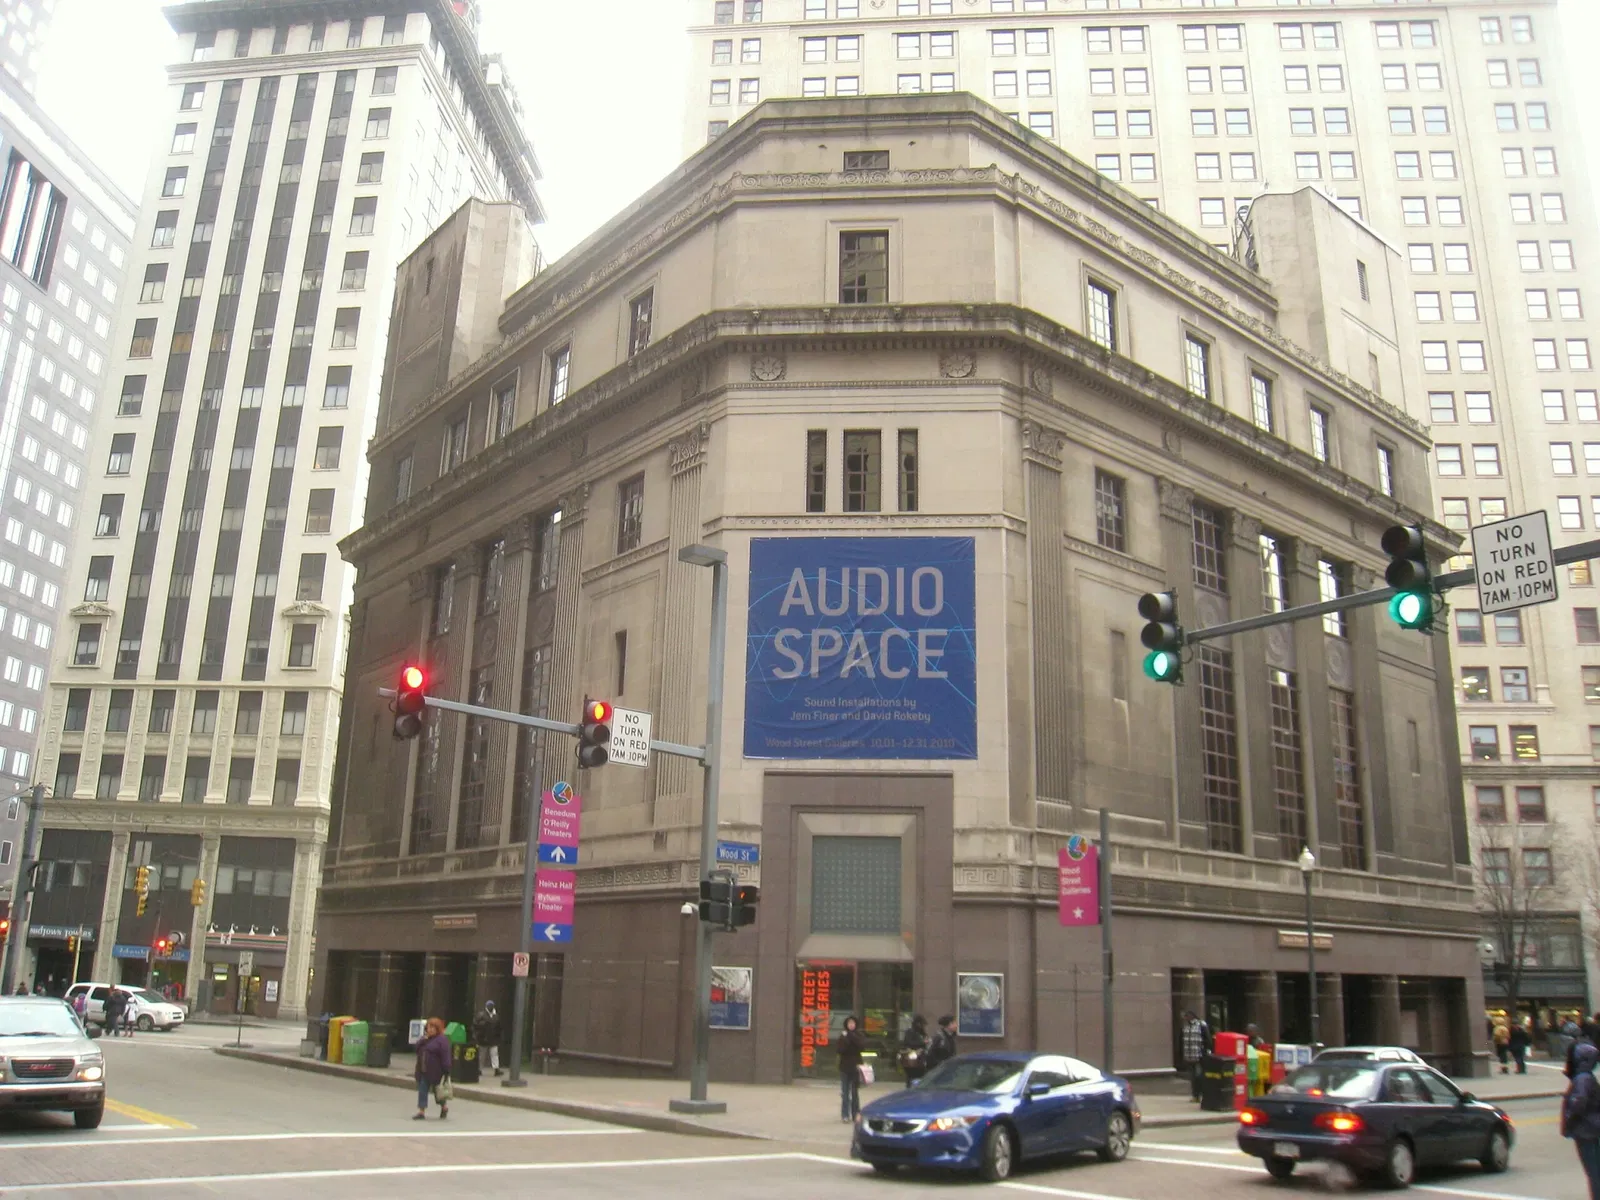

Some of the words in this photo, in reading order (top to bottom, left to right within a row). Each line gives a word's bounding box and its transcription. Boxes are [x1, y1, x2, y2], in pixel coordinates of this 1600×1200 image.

[1496, 525, 1523, 542] NO
[1490, 542, 1536, 564] TURN
[1483, 569, 1505, 586] ON
[1515, 560, 1548, 579] RED
[779, 566, 944, 617] AUDIO
[772, 628, 949, 679] SPACE
[804, 697, 836, 708] Sound
[838, 697, 901, 708] Installations
[904, 697, 917, 709] by
[625, 714, 639, 725] NO
[791, 711, 811, 721] Jem
[813, 711, 839, 721] Finer
[841, 711, 860, 721] and
[863, 711, 891, 721] David
[893, 711, 931, 723] Rokeby
[620, 725, 644, 738] TURN
[613, 737, 625, 747] ON
[630, 739, 647, 750] RED
[765, 737, 791, 748] Wood
[793, 737, 822, 748] Street
[544, 808, 576, 818] Benedum
[543, 818, 570, 830] O'Reilly
[543, 828, 572, 839] Theaters
[719, 848, 738, 859] Wood
[741, 850, 750, 861] St
[538, 880, 558, 889] Heinz
[559, 881, 573, 890] Hall
[537, 903, 563, 911] Theater
[802, 970, 816, 1023] STREET
[816, 970, 831, 1046] GALLERIES
[801, 1025, 815, 1067] WOOD
